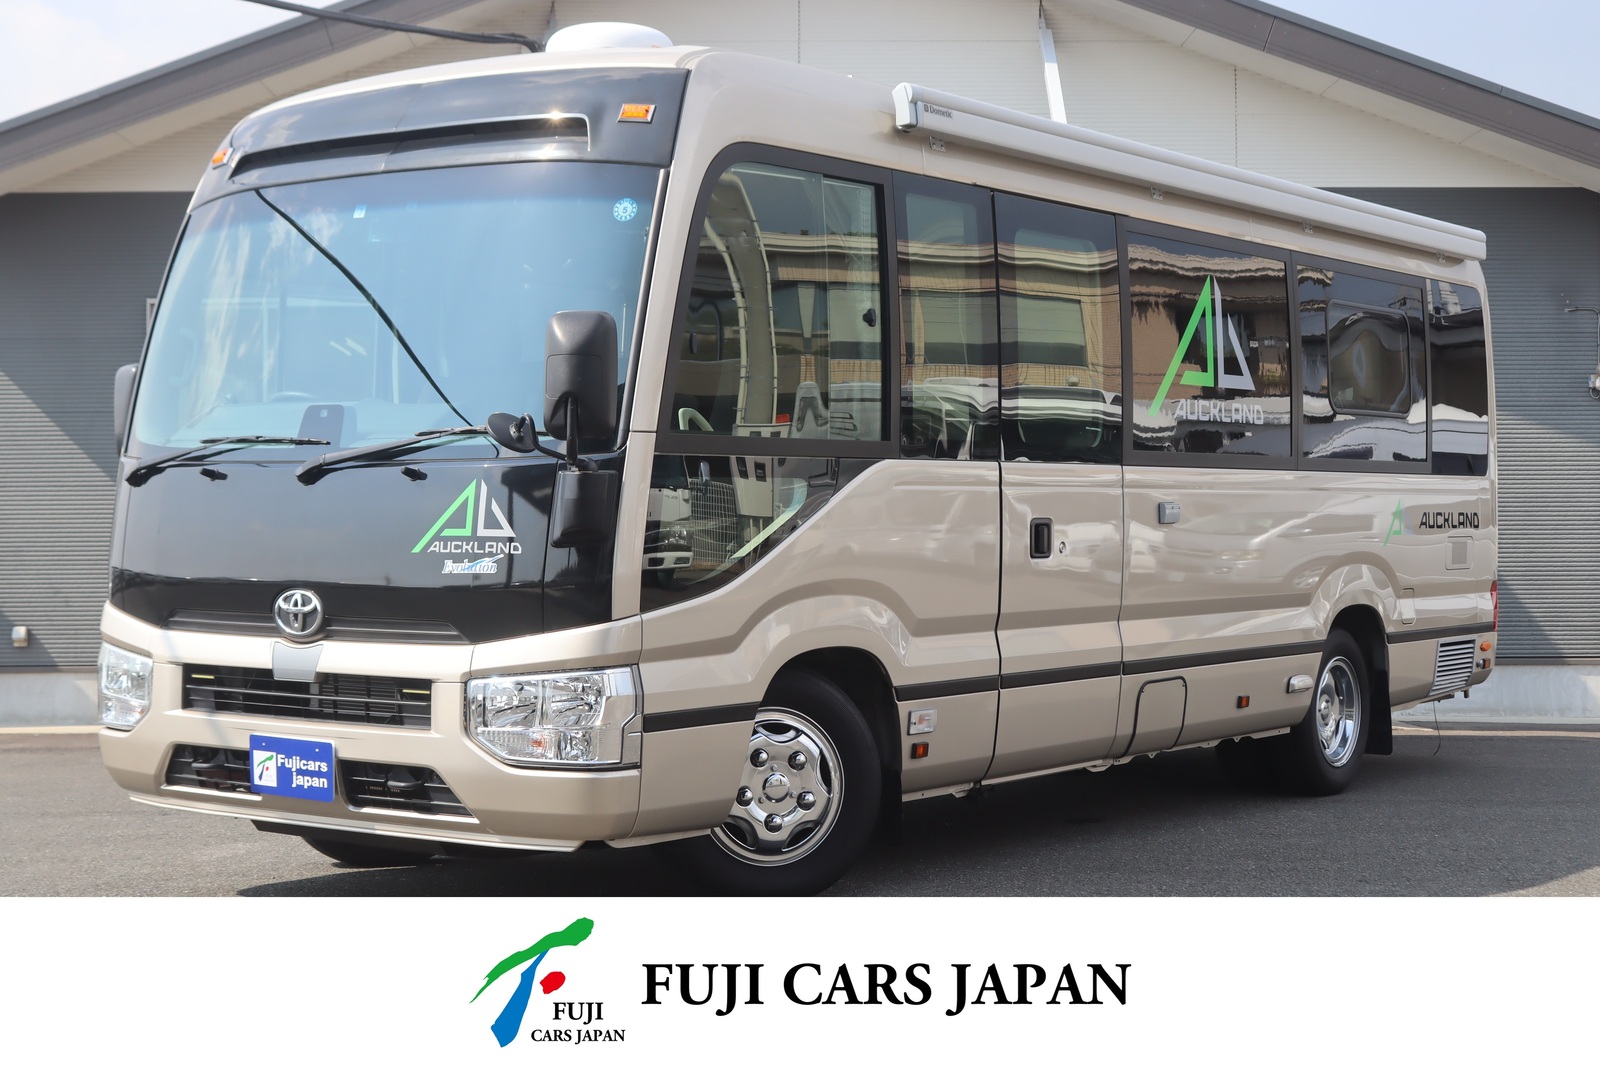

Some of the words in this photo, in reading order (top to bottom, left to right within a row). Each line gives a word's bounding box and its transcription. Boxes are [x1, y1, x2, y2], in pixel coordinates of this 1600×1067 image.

[929, 105, 953, 118] Dometic
[1174, 398, 1264, 425] AUCKLAND
[1418, 511, 1480, 529] AUCKLAND
[427, 541, 522, 554] AUCKLAND
[442, 559, 498, 574] Evolution
[277, 754, 328, 772] Fujicars
